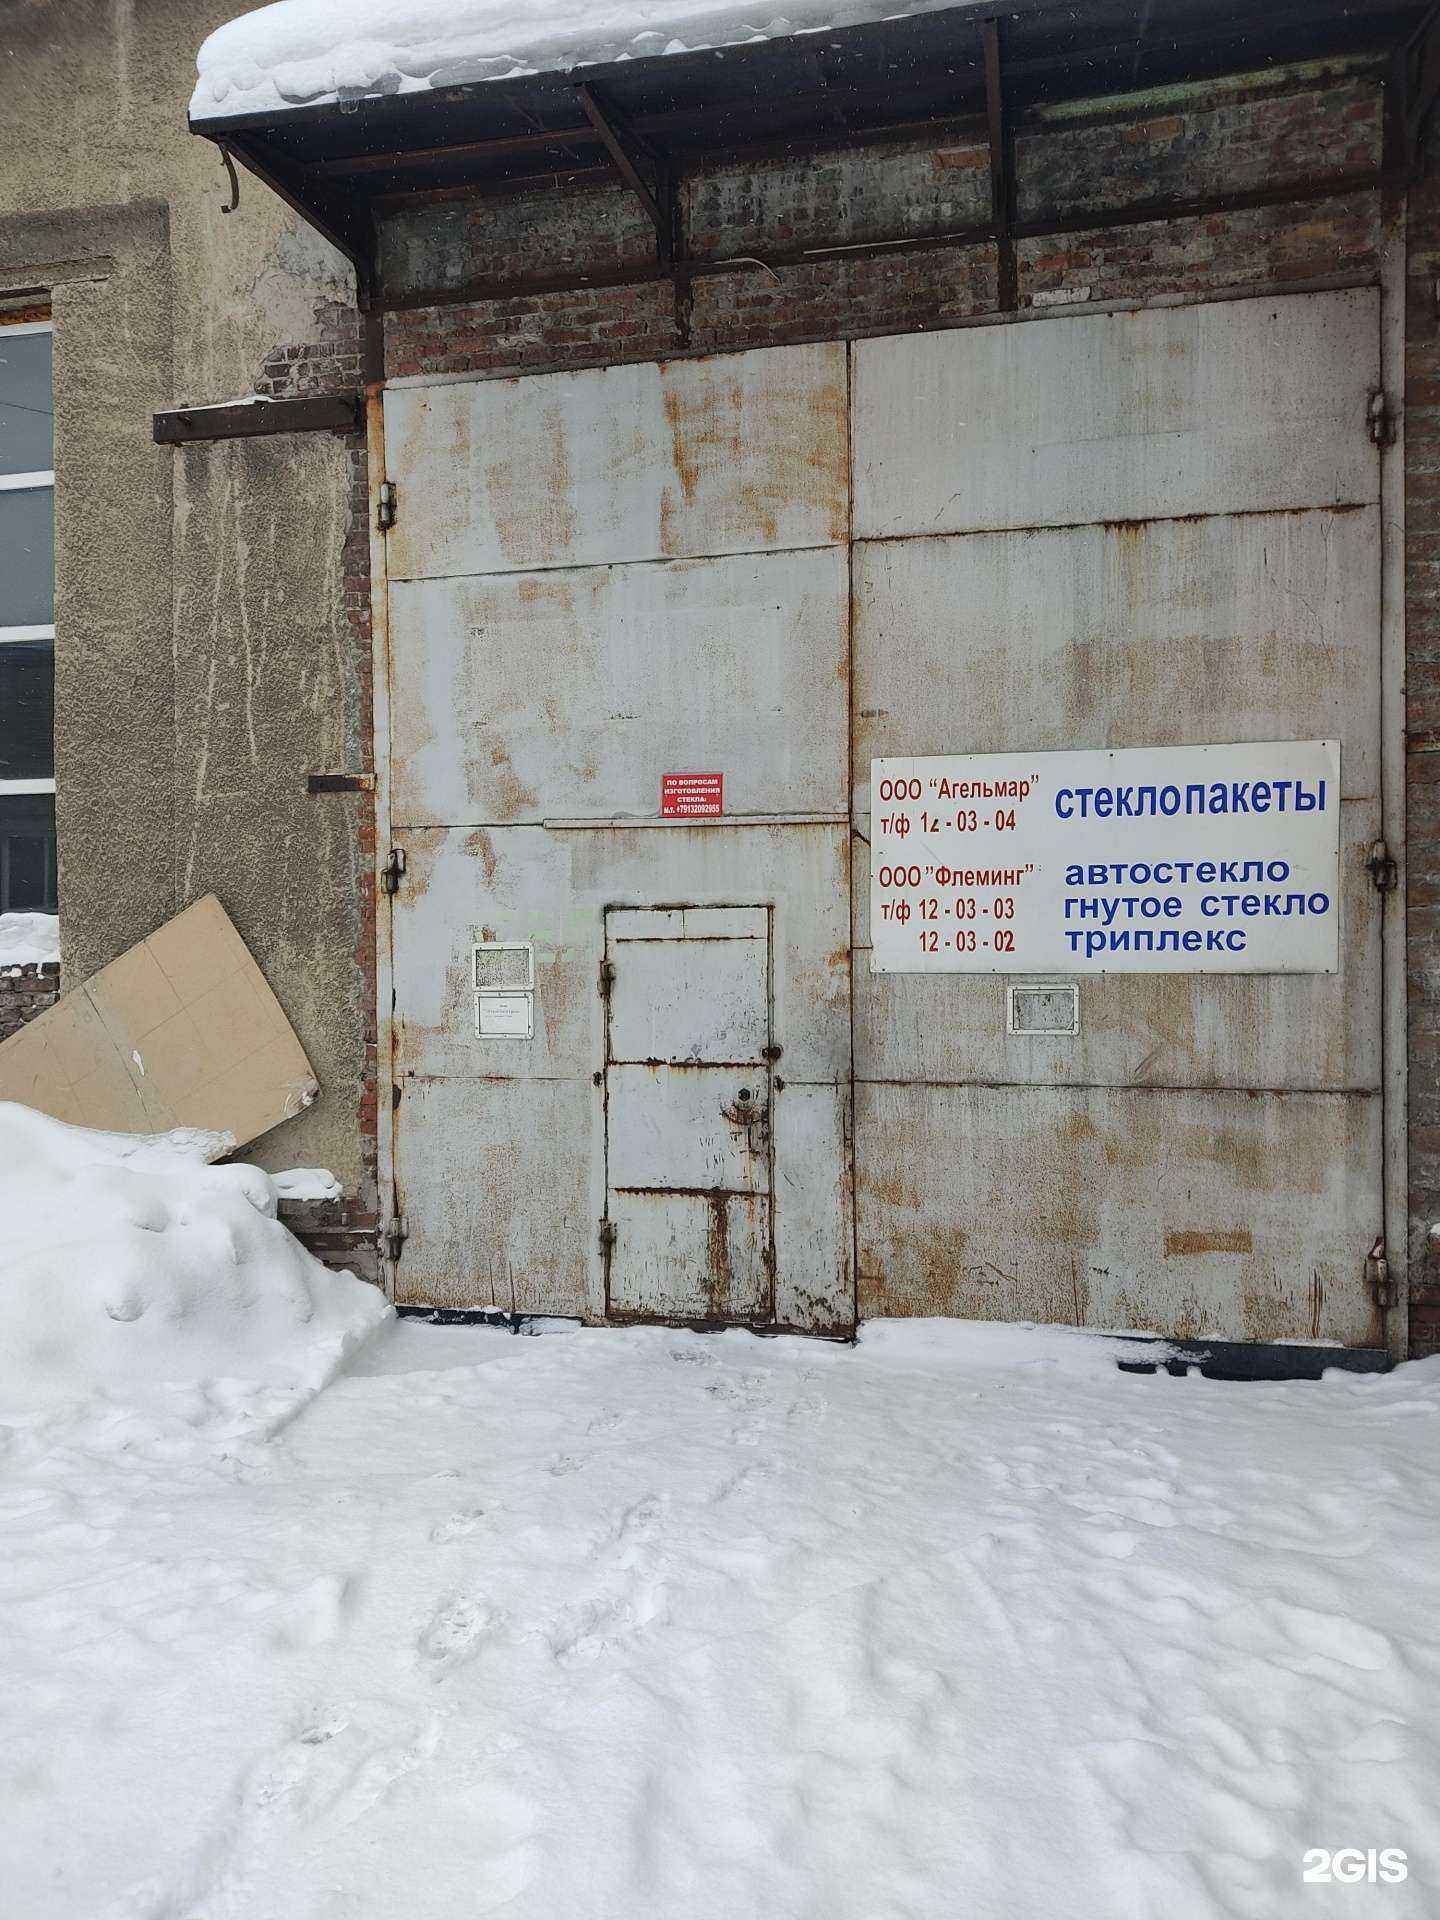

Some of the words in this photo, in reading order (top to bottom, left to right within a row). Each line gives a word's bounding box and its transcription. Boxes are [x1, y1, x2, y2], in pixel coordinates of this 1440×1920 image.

[664, 787, 721, 795] ИЗГОТОВЛЕНИЯ
[678, 778, 719, 786] ВОПРОСАМ
[879, 778, 922, 801] ООО
[1055, 780, 1326, 819] стеклопакеты
[880, 812, 911, 839] т/ф
[879, 865, 922, 888] ООО
[1065, 860, 1290, 886] автостекло
[880, 899, 911, 926] т/ф
[1064, 896, 1182, 926] гнутое
[1200, 892, 1330, 917] стекло
[1065, 929, 1247, 958] триплекс
